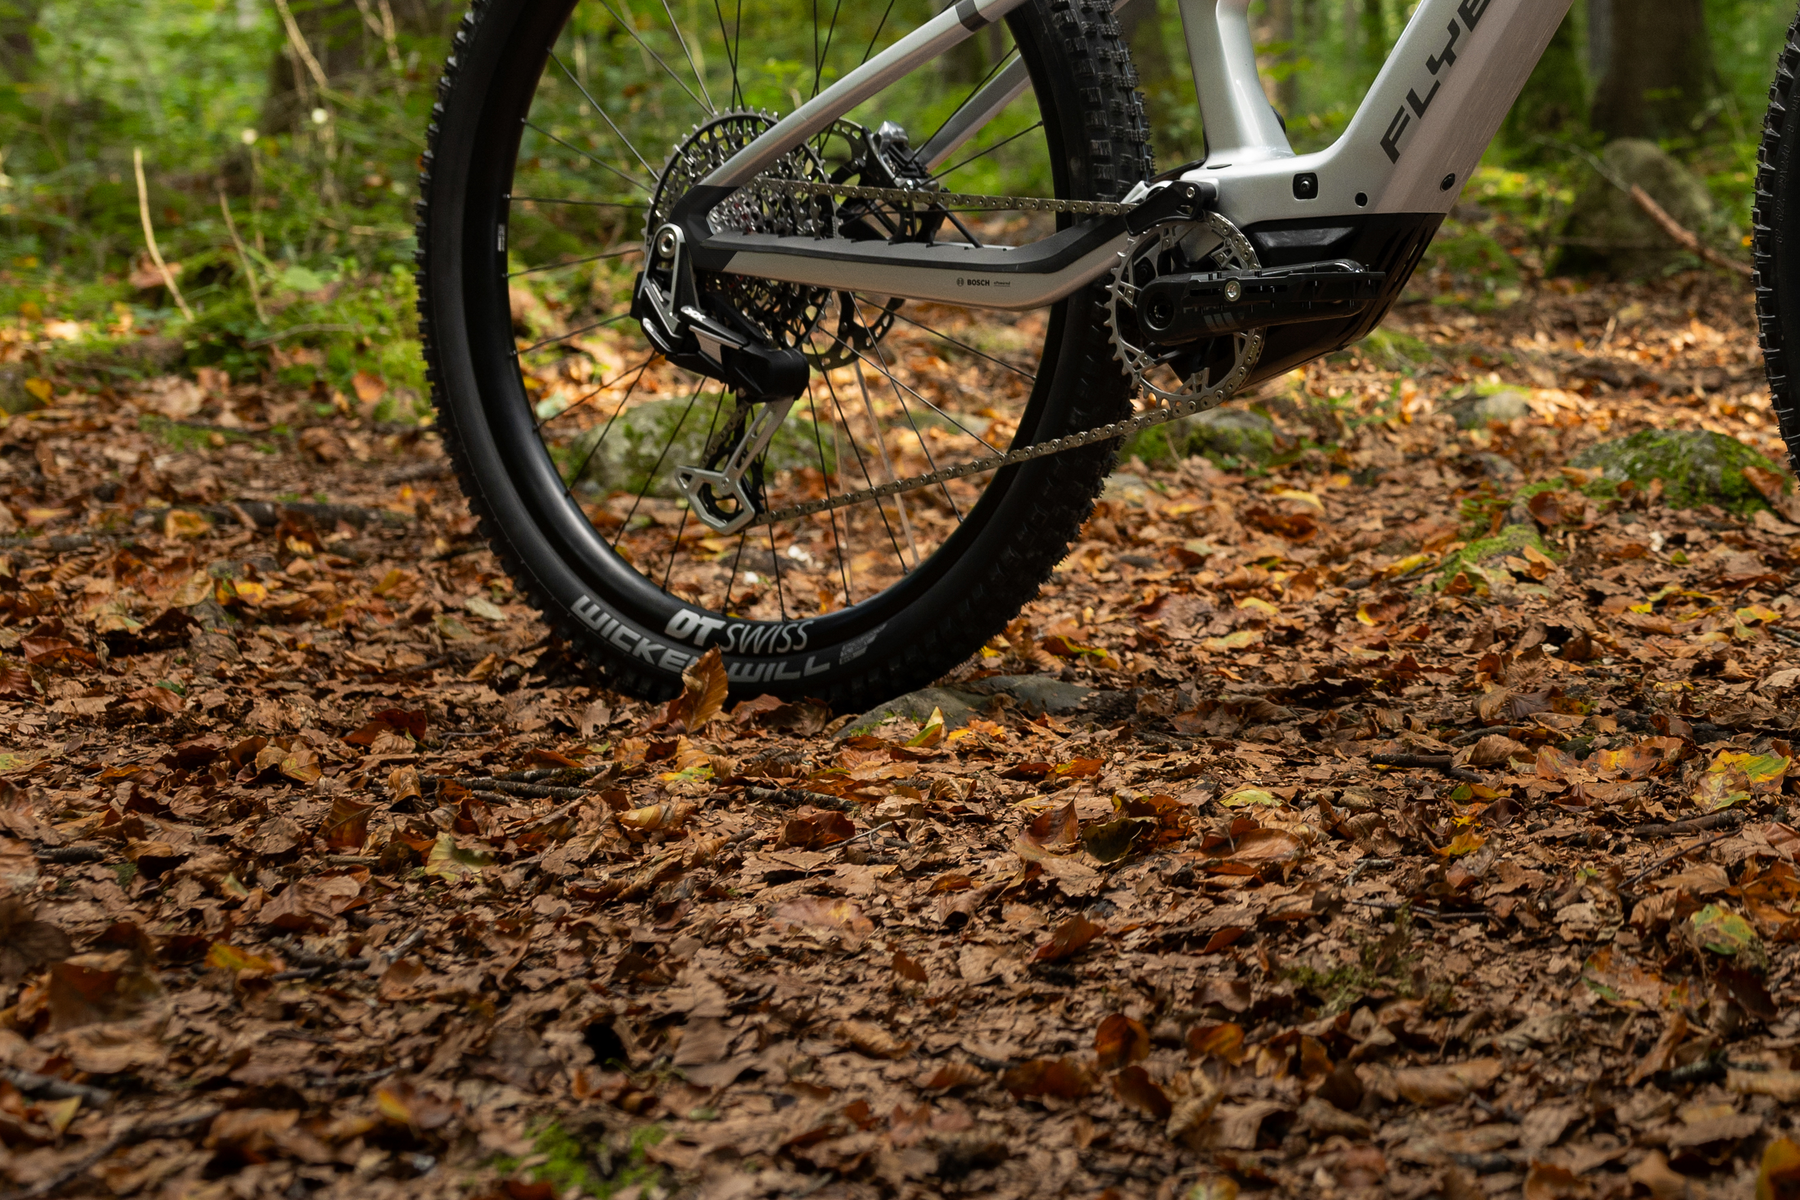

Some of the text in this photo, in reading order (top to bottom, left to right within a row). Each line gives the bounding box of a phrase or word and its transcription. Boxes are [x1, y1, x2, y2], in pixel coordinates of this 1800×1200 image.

[664, 608, 727, 647] DT
[720, 620, 814, 654] SWISS
[728, 656, 831, 683] WILL
